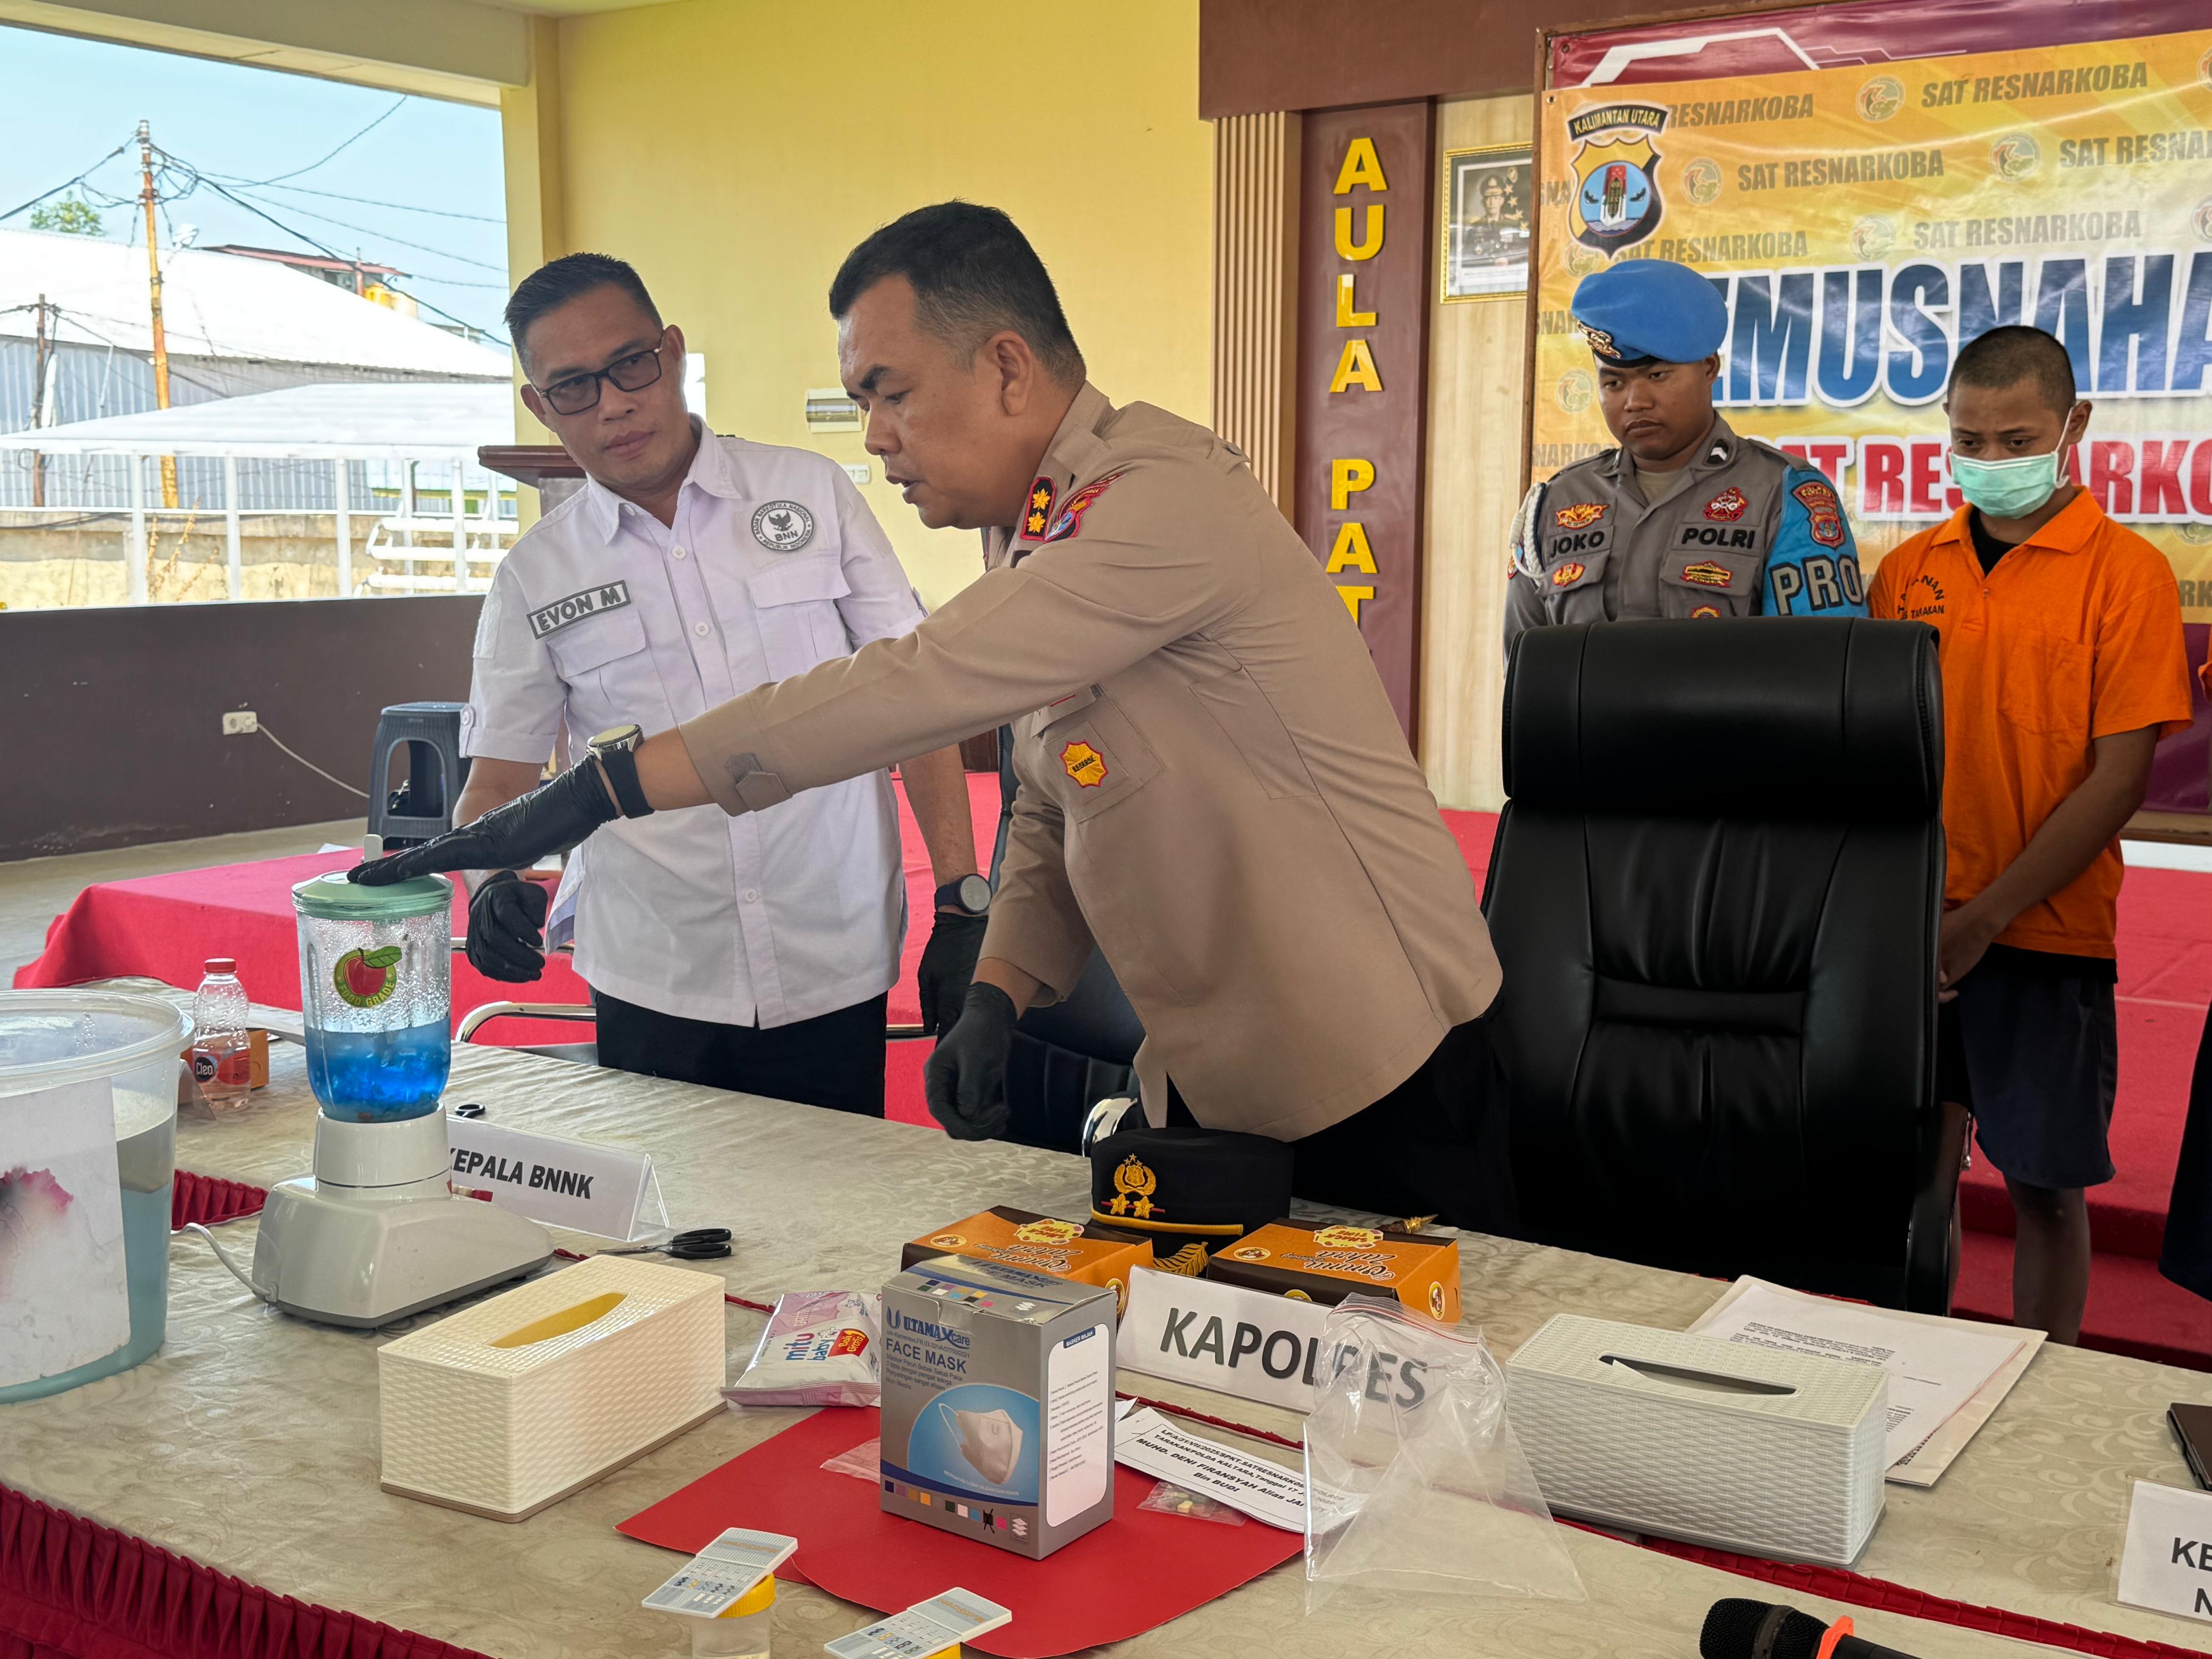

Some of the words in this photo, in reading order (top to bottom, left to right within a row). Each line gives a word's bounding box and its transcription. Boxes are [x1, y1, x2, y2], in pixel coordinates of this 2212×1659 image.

[1921, 81, 1969, 107] SAT
[1972, 62, 2148, 103] RESNARKOBA
[1574, 108, 1629, 135] KALIMANTAN
[1631, 110, 1661, 128] UTARA
[2059, 137, 2109, 168] SAT
[1738, 163, 1779, 191] SAT
[1784, 149, 1944, 188] RESNARKOBA
[1914, 221, 1960, 250] SAT
[1965, 210, 2141, 246] RESNARKOBA
[1660, 230, 1808, 263] RESNARKOBA
[1333, 137, 1389, 393] AULA
[775, 530, 799, 542] BNN
[1549, 531, 1605, 558] JOKO
[1681, 527, 1755, 549] POLRI
[536, 594, 594, 632] EVON
[600, 586, 622, 607] M
[338, 984, 362, 1007] FOOD
[366, 981, 396, 1008] GRADE
[196, 1061, 213, 1075] Cleo
[450, 1147, 524, 1185] EPALA
[529, 1164, 595, 1200] BNNK
[1324, 1233, 1369, 1243] SNACK
[1315, 1250, 1397, 1265] Zahra
[783, 1333, 815, 1361] mitu
[807, 1339, 835, 1361] baby
[838, 1335, 852, 1348] Beli
[847, 1336, 864, 1353] Gratis
[886, 1337, 920, 1361] FACE
[925, 1350, 967, 1374] MASK
[1136, 1438, 1168, 1455] MUHD.
[1170, 1453, 1197, 1465] DENI
[1197, 1463, 1259, 1489] FIRANSYAH
[1257, 1487, 1285, 1499] Alias
[1193, 1472, 1211, 1481] Bin
[1211, 1479, 1241, 1492] BUDI
